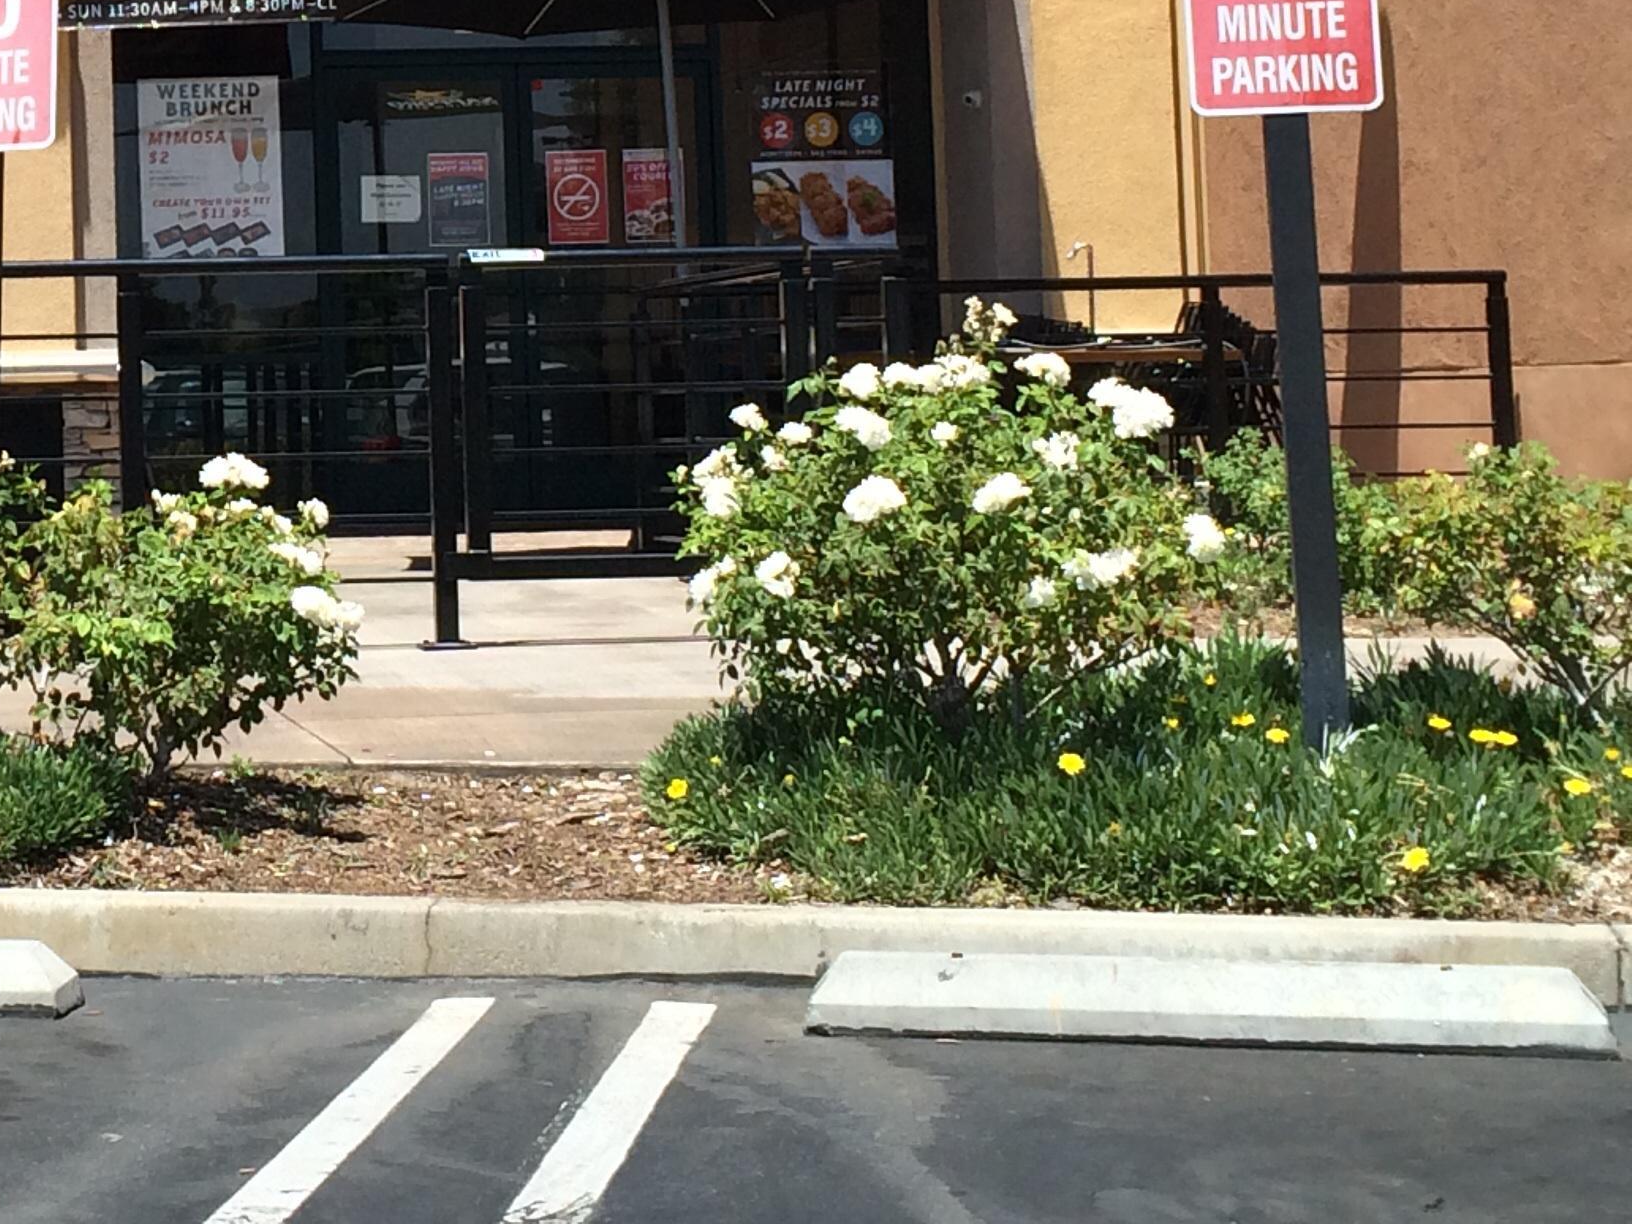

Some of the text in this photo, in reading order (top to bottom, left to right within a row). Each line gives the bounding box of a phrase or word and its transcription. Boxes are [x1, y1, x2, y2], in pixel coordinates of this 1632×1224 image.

[68, 3, 102, 19] SUN
[229, 0, 241, 14] &
[1216, 0, 1347, 43] MINUTE
[1211, 51, 1359, 96] PARKING
[156, 82, 261, 100] WEEKEND
[775, 78, 866, 93] LATE NIGHT
[166, 99, 252, 117] BRUNCH
[760, 96, 833, 110] SPECIALS
[763, 120, 788, 139] $2
[808, 118, 832, 138] $3
[852, 117, 877, 138] $4
[148, 129, 226, 146] MIMOSA
[148, 150, 170, 165] $2
